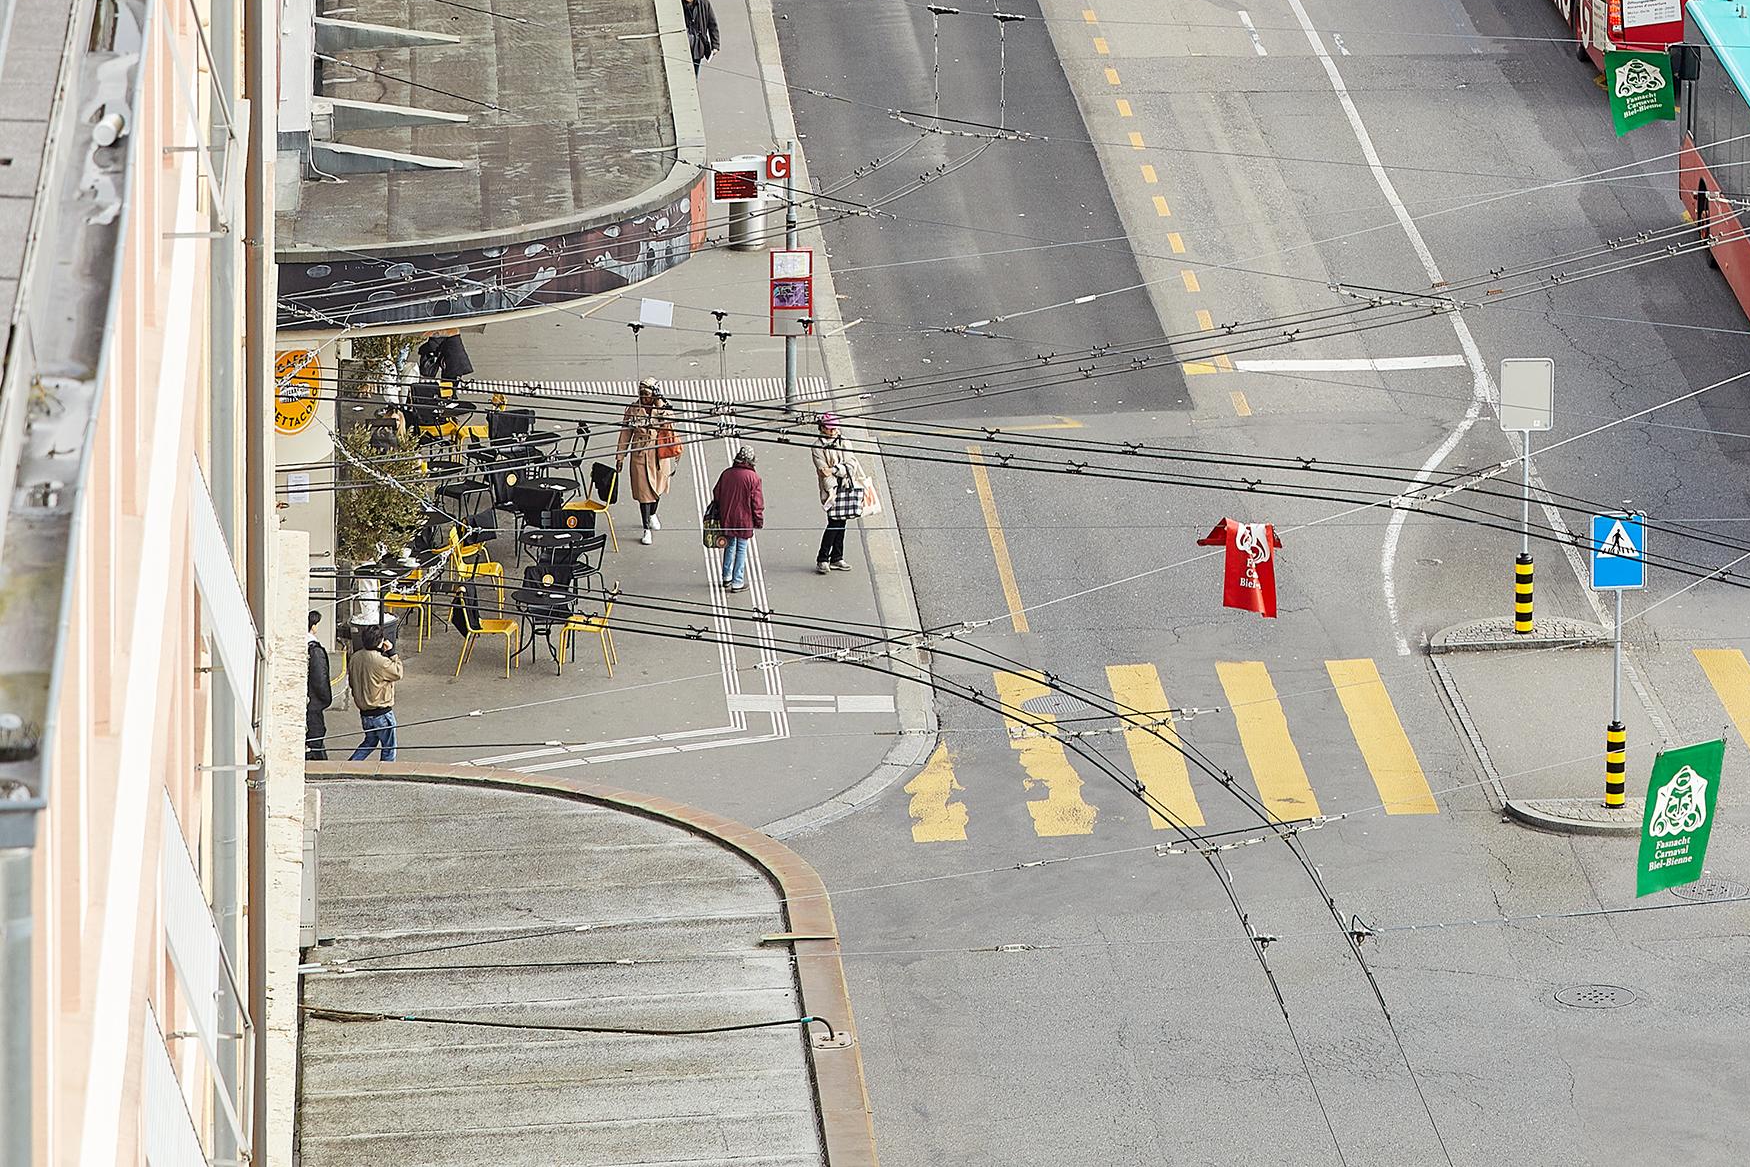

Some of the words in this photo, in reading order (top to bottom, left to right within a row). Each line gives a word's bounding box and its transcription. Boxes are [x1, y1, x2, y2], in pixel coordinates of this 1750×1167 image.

[770, 156, 786, 177] C
[1656, 836, 1691, 850] Fasnacht
[1654, 845, 1689, 860] Carnaval
[1648, 856, 1693, 872] Biel-Bienne
